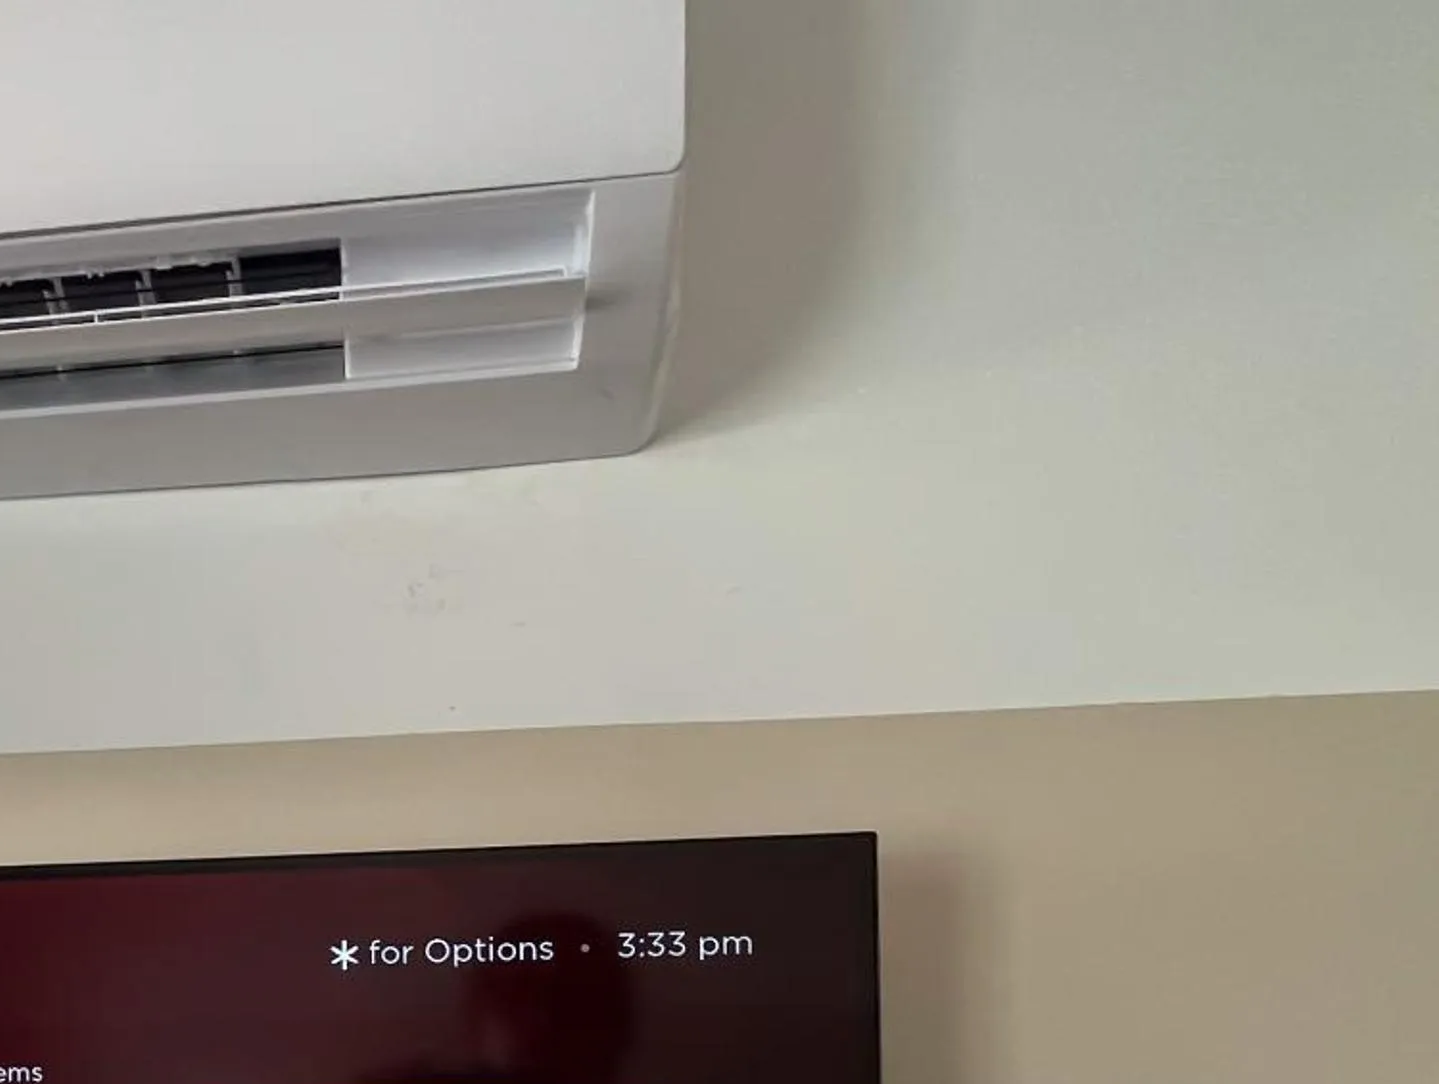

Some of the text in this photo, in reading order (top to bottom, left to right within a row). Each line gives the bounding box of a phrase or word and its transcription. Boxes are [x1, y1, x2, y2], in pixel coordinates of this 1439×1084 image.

[369, 931, 754, 968] for Options 3:33 pm
